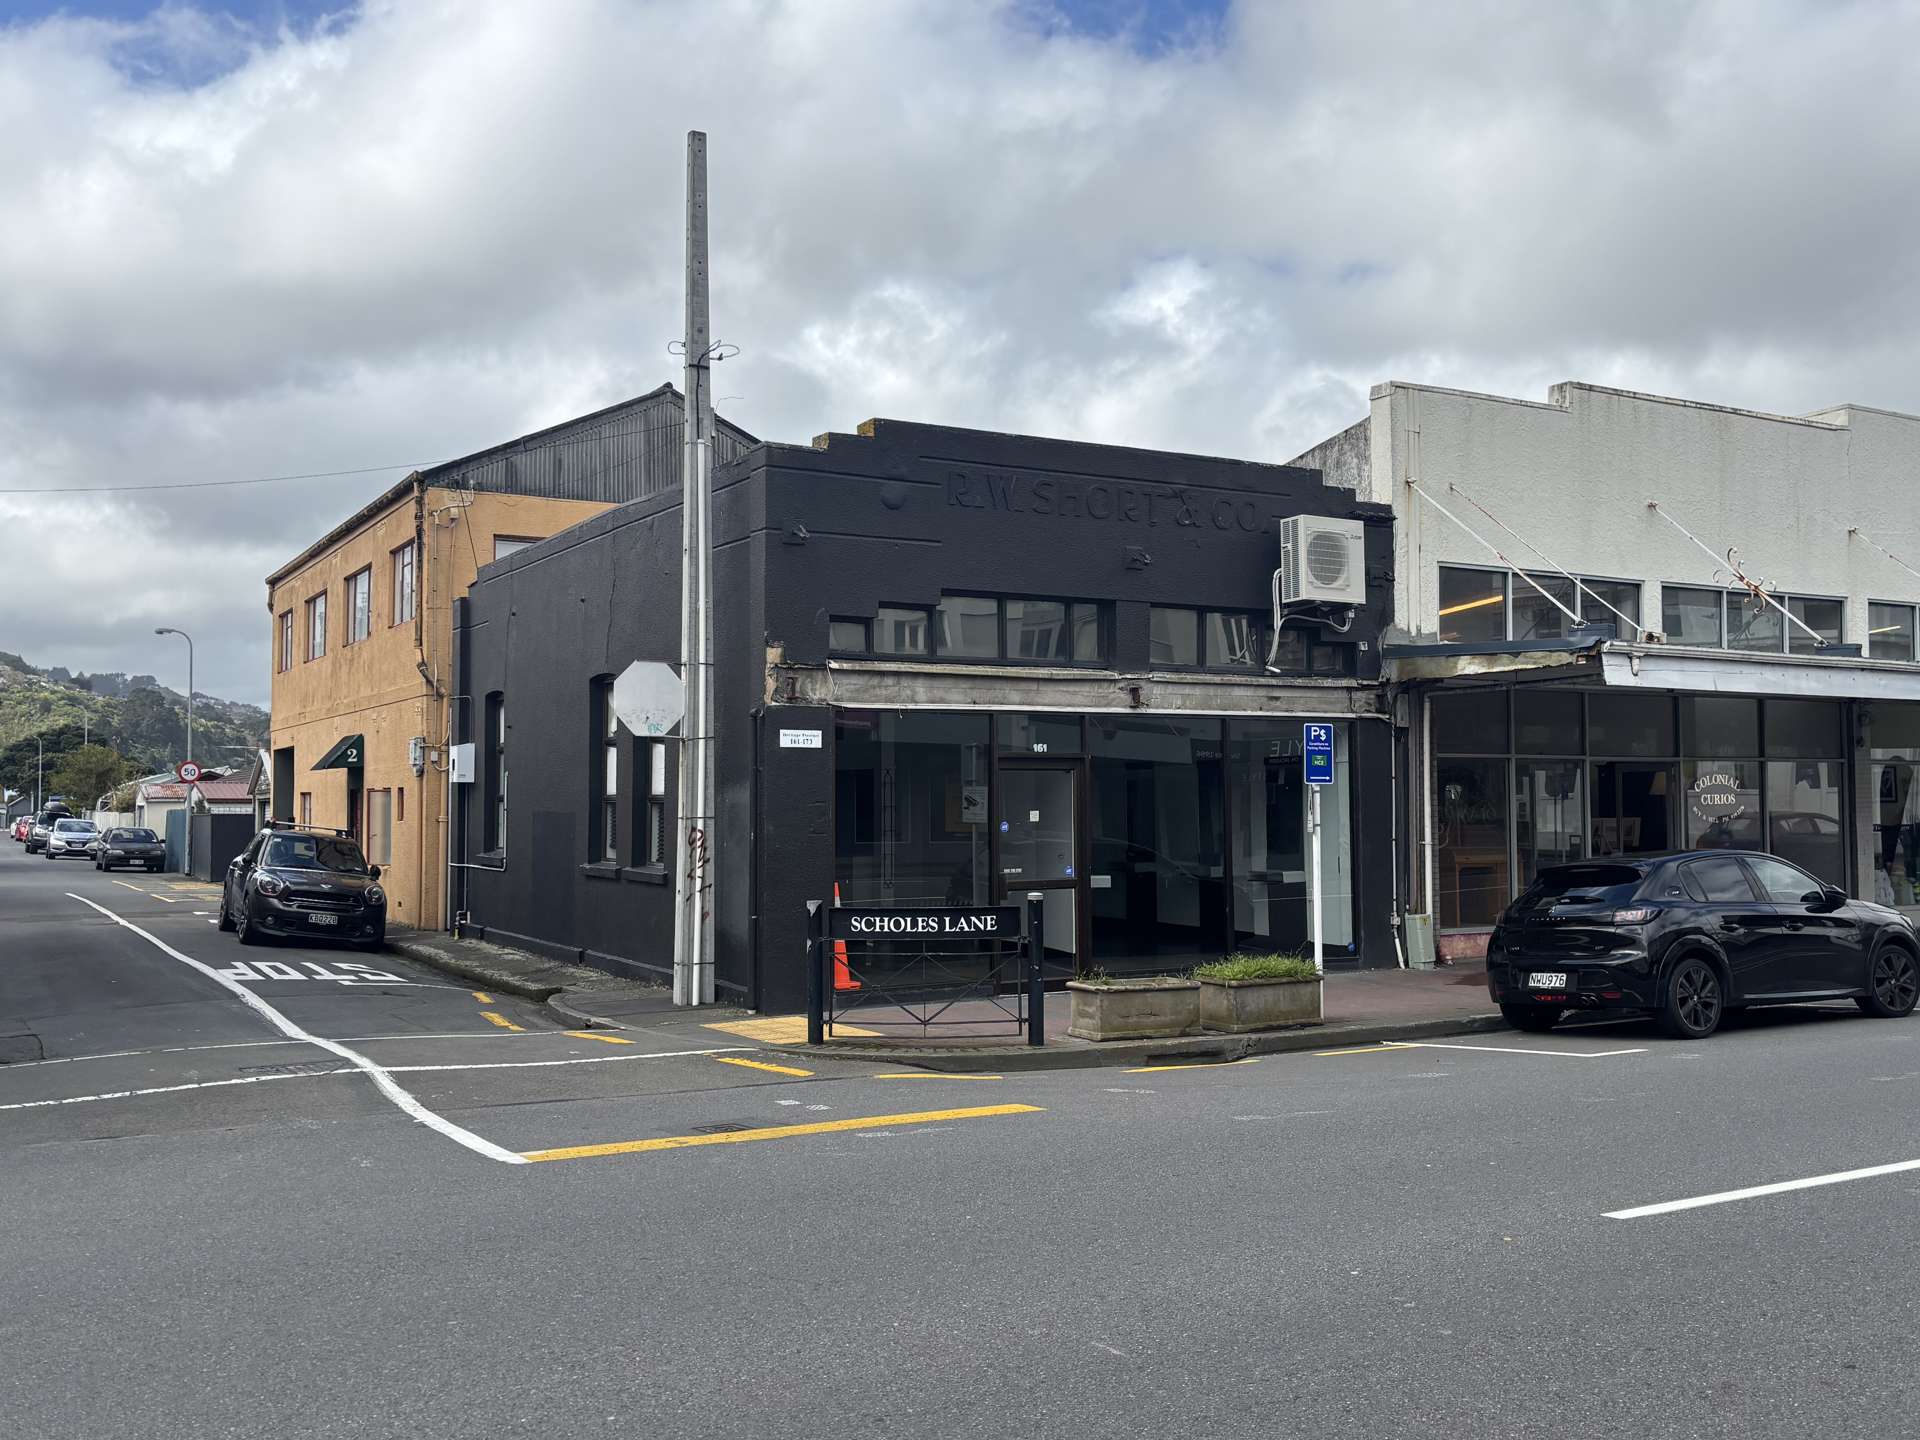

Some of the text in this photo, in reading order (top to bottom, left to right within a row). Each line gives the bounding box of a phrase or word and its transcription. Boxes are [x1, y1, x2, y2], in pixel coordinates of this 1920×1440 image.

[1032, 480, 1166, 527] SHORT
[1175, 491, 1203, 527] &
[346, 748, 358, 762] 2
[1032, 743, 1048, 753] 161
[183, 767, 197, 777] 50
[1694, 774, 1740, 792] COLONIAL
[1701, 793, 1736, 805] CURIOS
[850, 915, 998, 932] SCHOLES LANE
